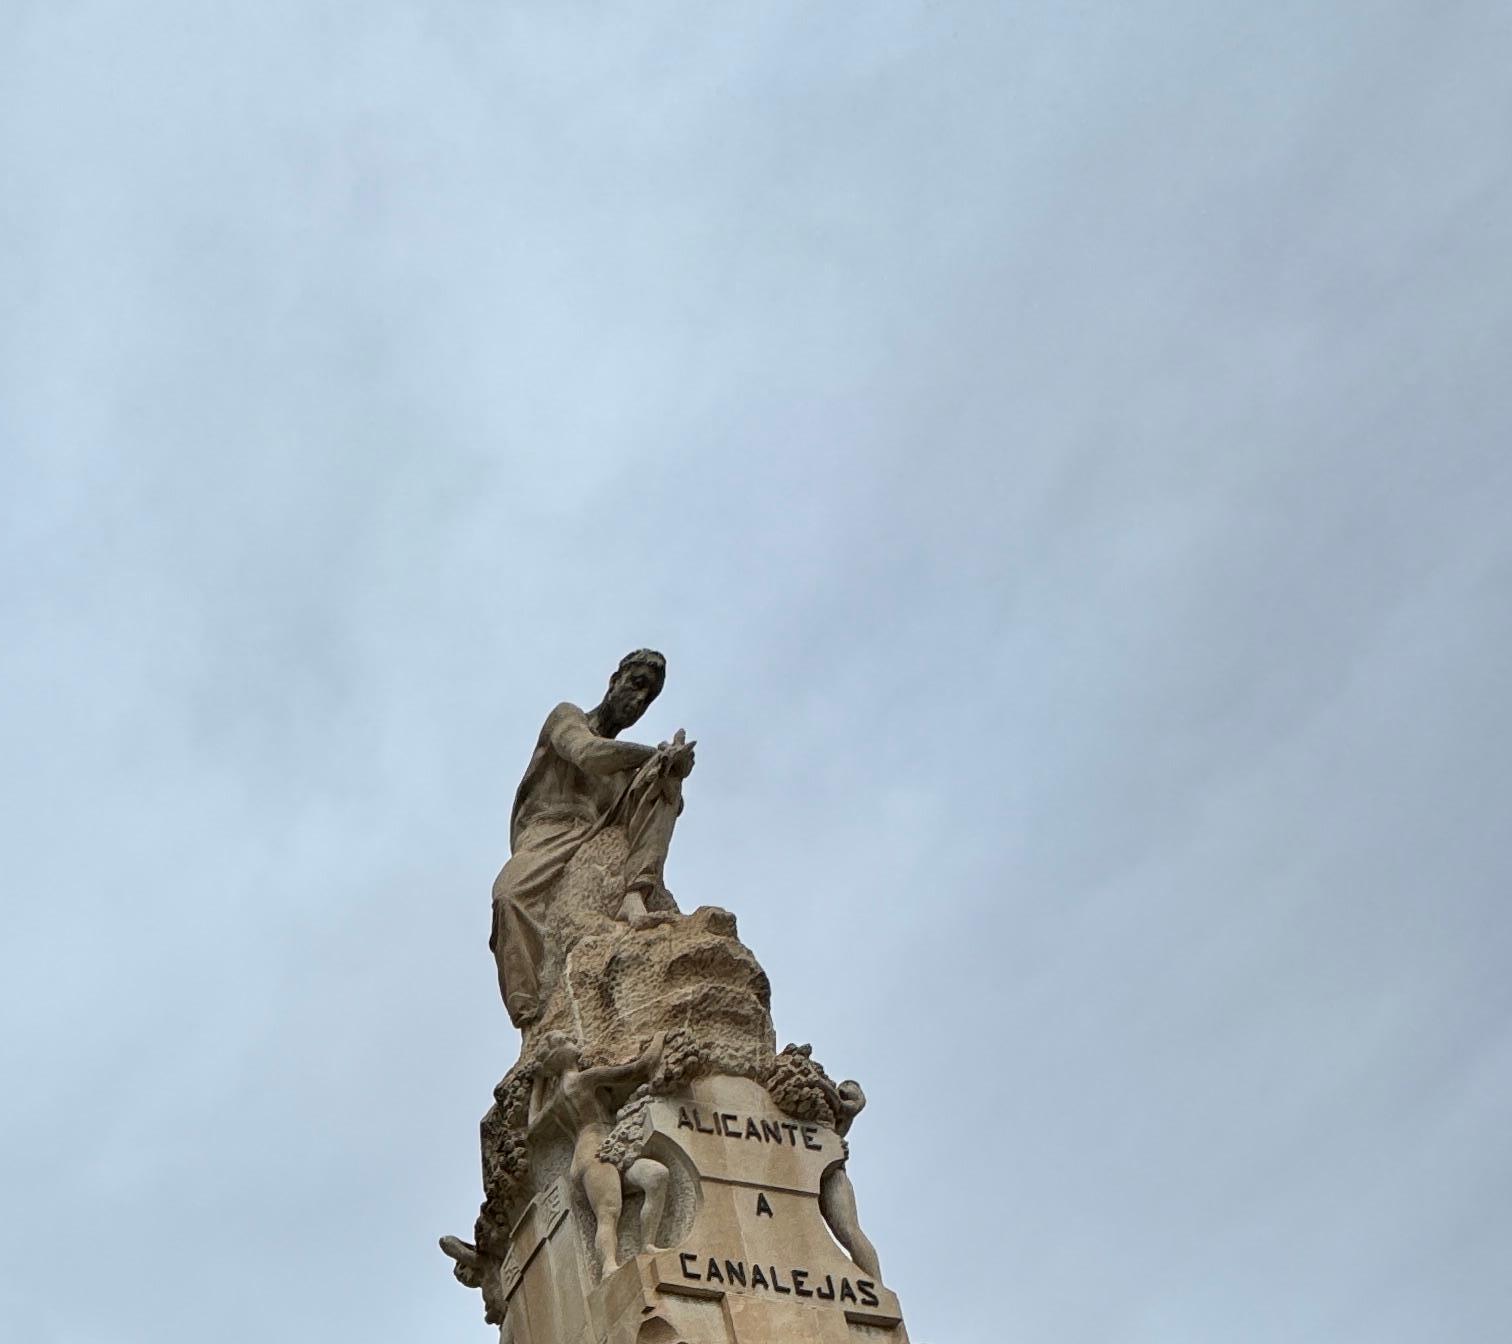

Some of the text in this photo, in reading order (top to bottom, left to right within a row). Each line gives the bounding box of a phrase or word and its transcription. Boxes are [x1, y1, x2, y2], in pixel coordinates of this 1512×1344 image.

[678, 1107, 822, 1151] ALICANTE
[756, 1193, 773, 1218] A
[680, 1253, 879, 1307] CANALEJAS
